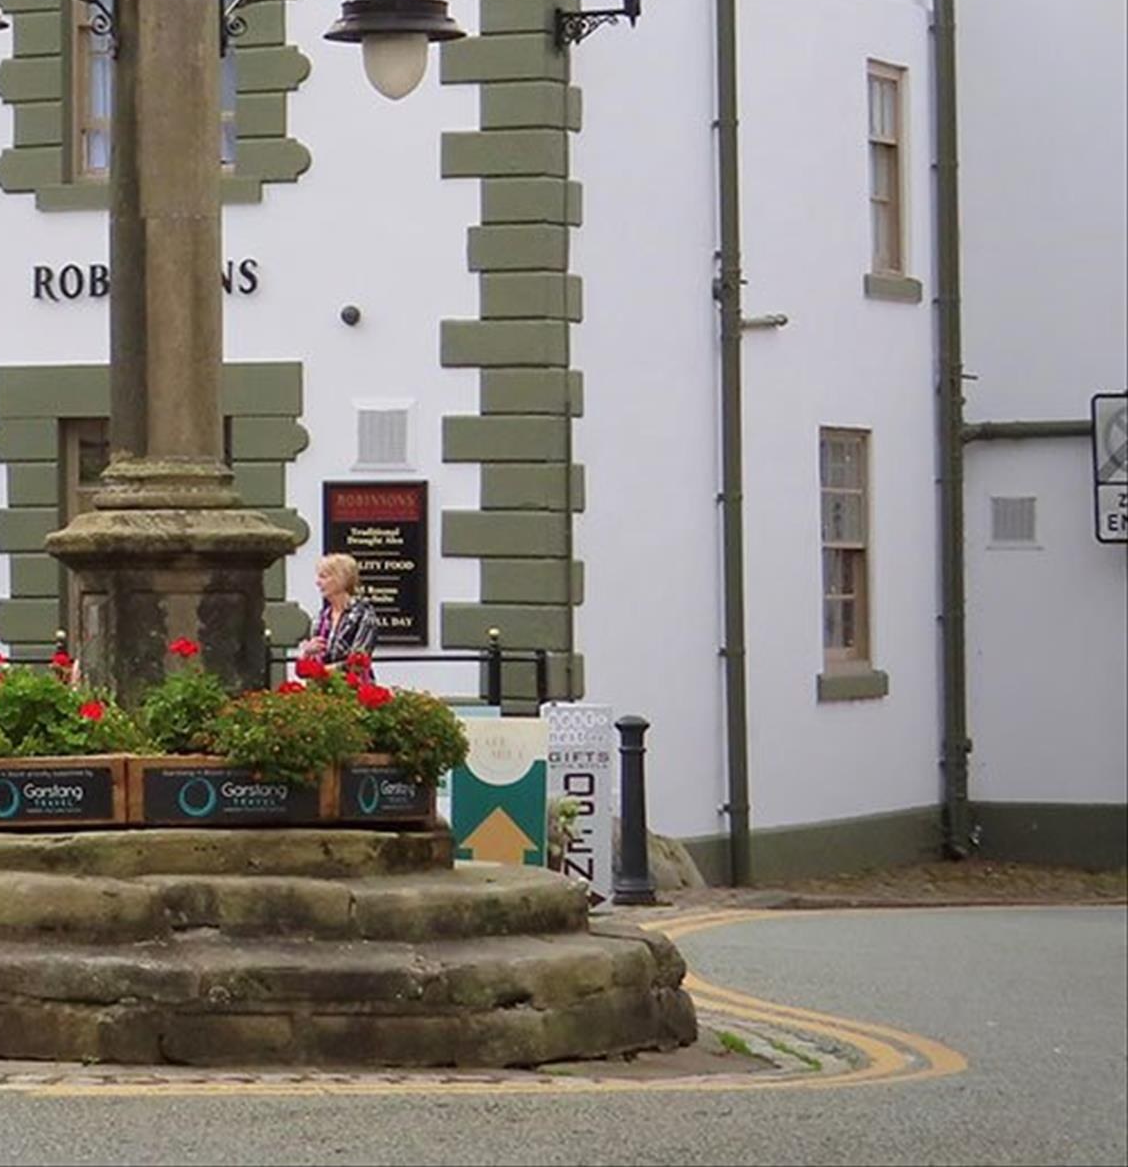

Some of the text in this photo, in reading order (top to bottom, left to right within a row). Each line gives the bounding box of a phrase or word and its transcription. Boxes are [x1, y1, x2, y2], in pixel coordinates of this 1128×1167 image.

[33, 260, 258, 301] ROBNS
[351, 527, 400, 536] Traditional
[385, 560, 416, 570] FOOD
[391, 616, 413, 627] DAY
[548, 751, 610, 763] GIFTS
[23, 783, 83, 802] Garstang
[222, 782, 287, 800] Garstang
